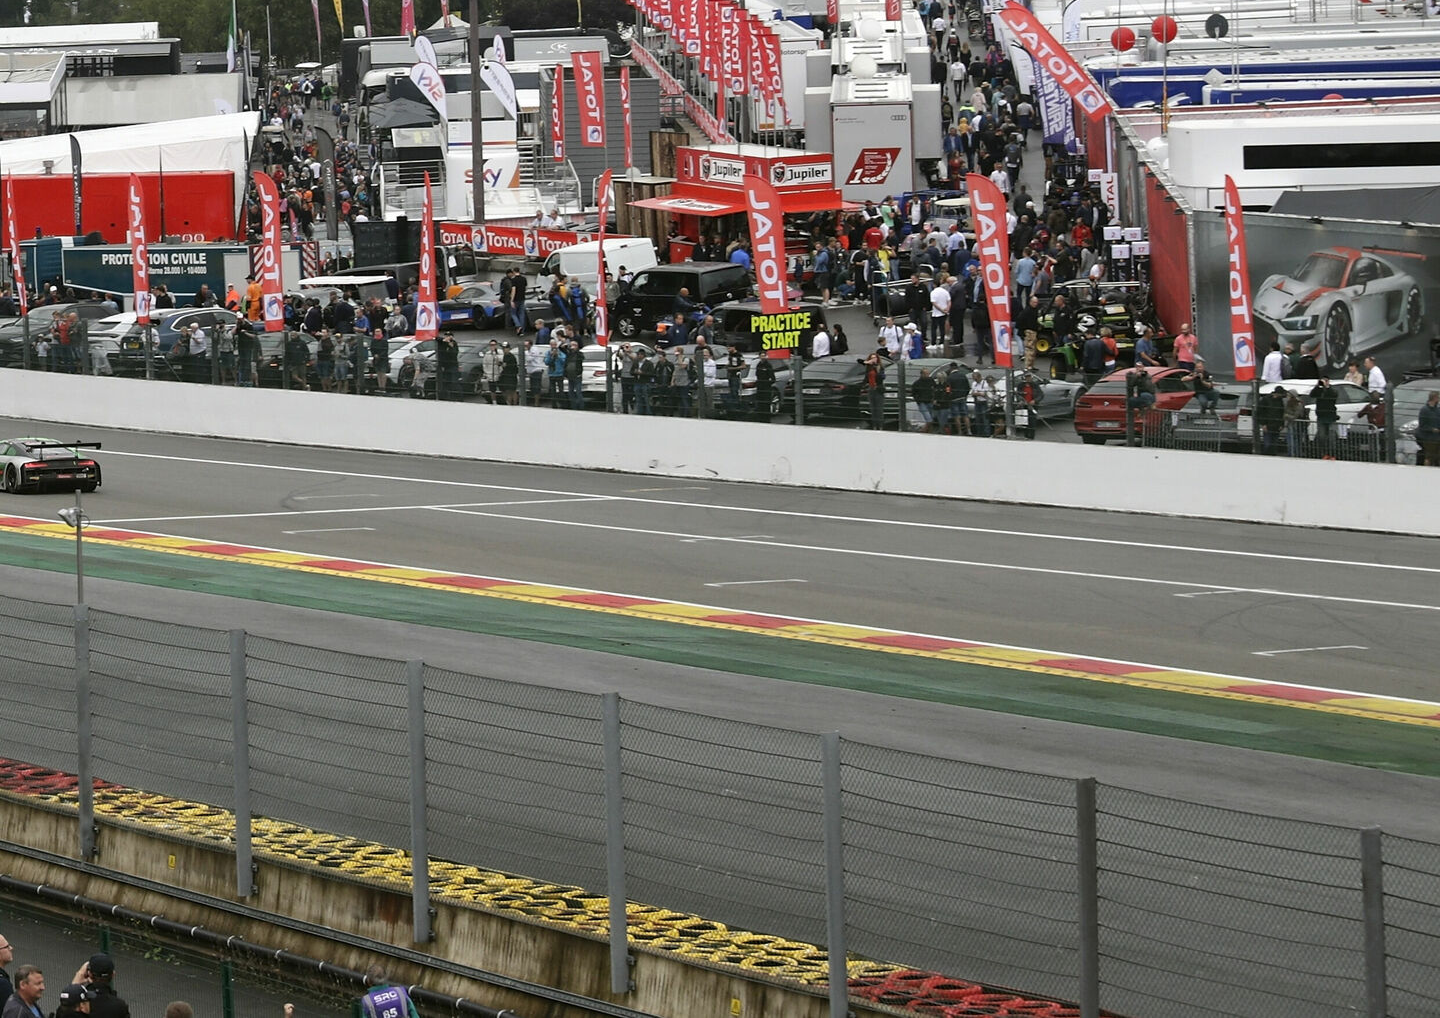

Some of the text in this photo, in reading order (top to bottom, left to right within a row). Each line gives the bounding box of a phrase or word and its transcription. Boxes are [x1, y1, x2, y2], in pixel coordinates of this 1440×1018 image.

[713, 162, 742, 178] Jupiler
[789, 167, 828, 180] Jupiler
[849, 169, 864, 183] 1
[487, 232, 523, 249] TOTAL
[101, 253, 206, 265] PROTEION CIVILE
[751, 312, 811, 333] PRACTICE
[762, 331, 801, 350] START
